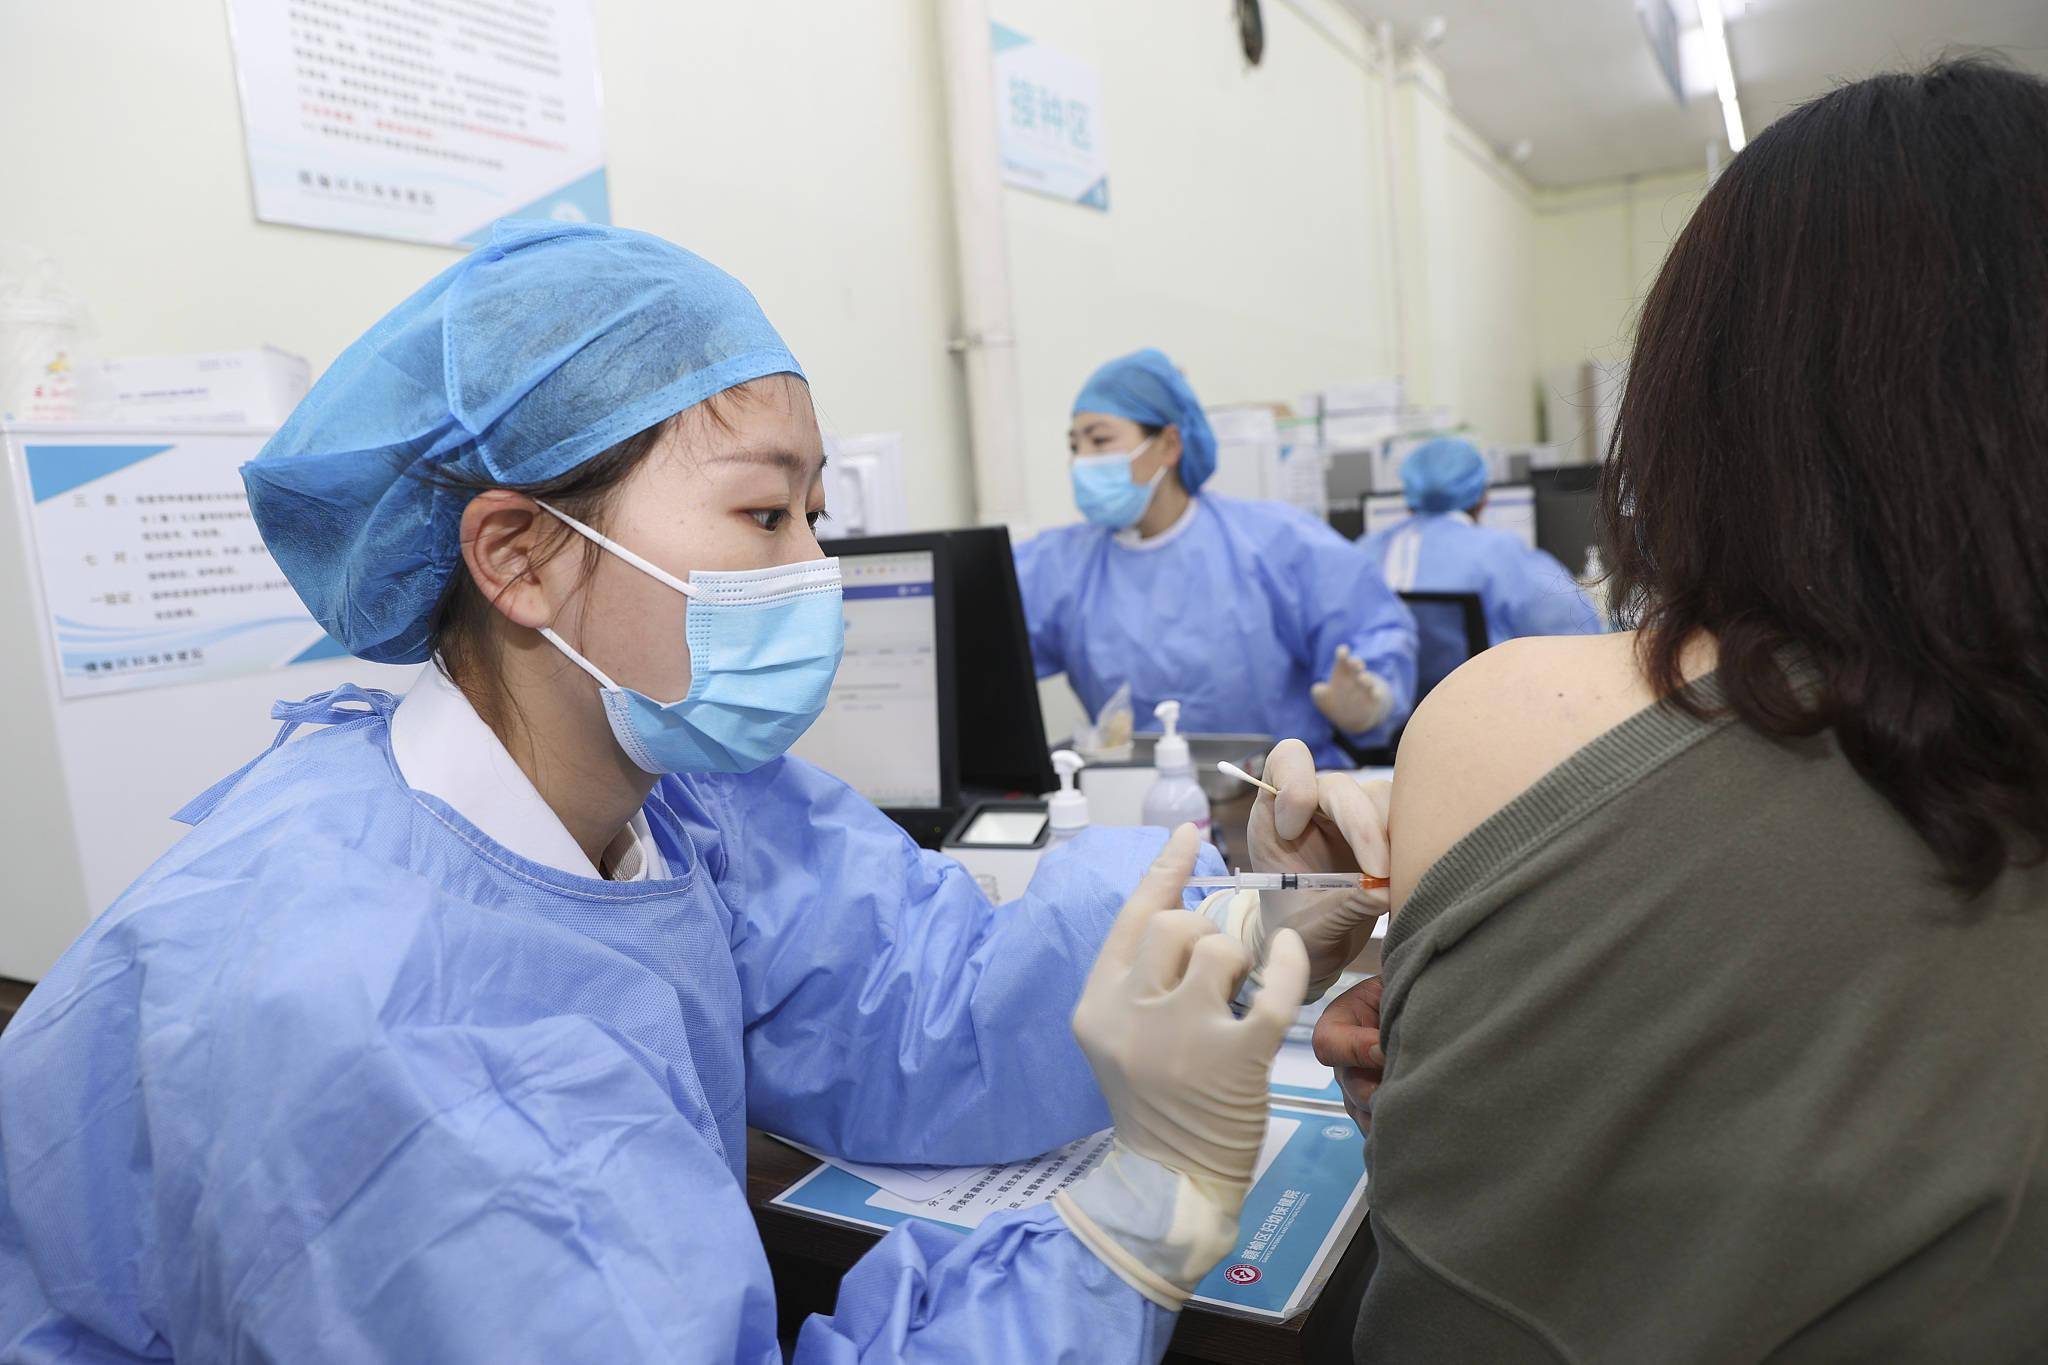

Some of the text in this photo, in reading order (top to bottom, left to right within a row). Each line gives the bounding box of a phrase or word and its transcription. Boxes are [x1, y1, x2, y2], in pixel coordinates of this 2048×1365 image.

[1241, 1189, 1301, 1261] 赣榆区妇幼保健院
